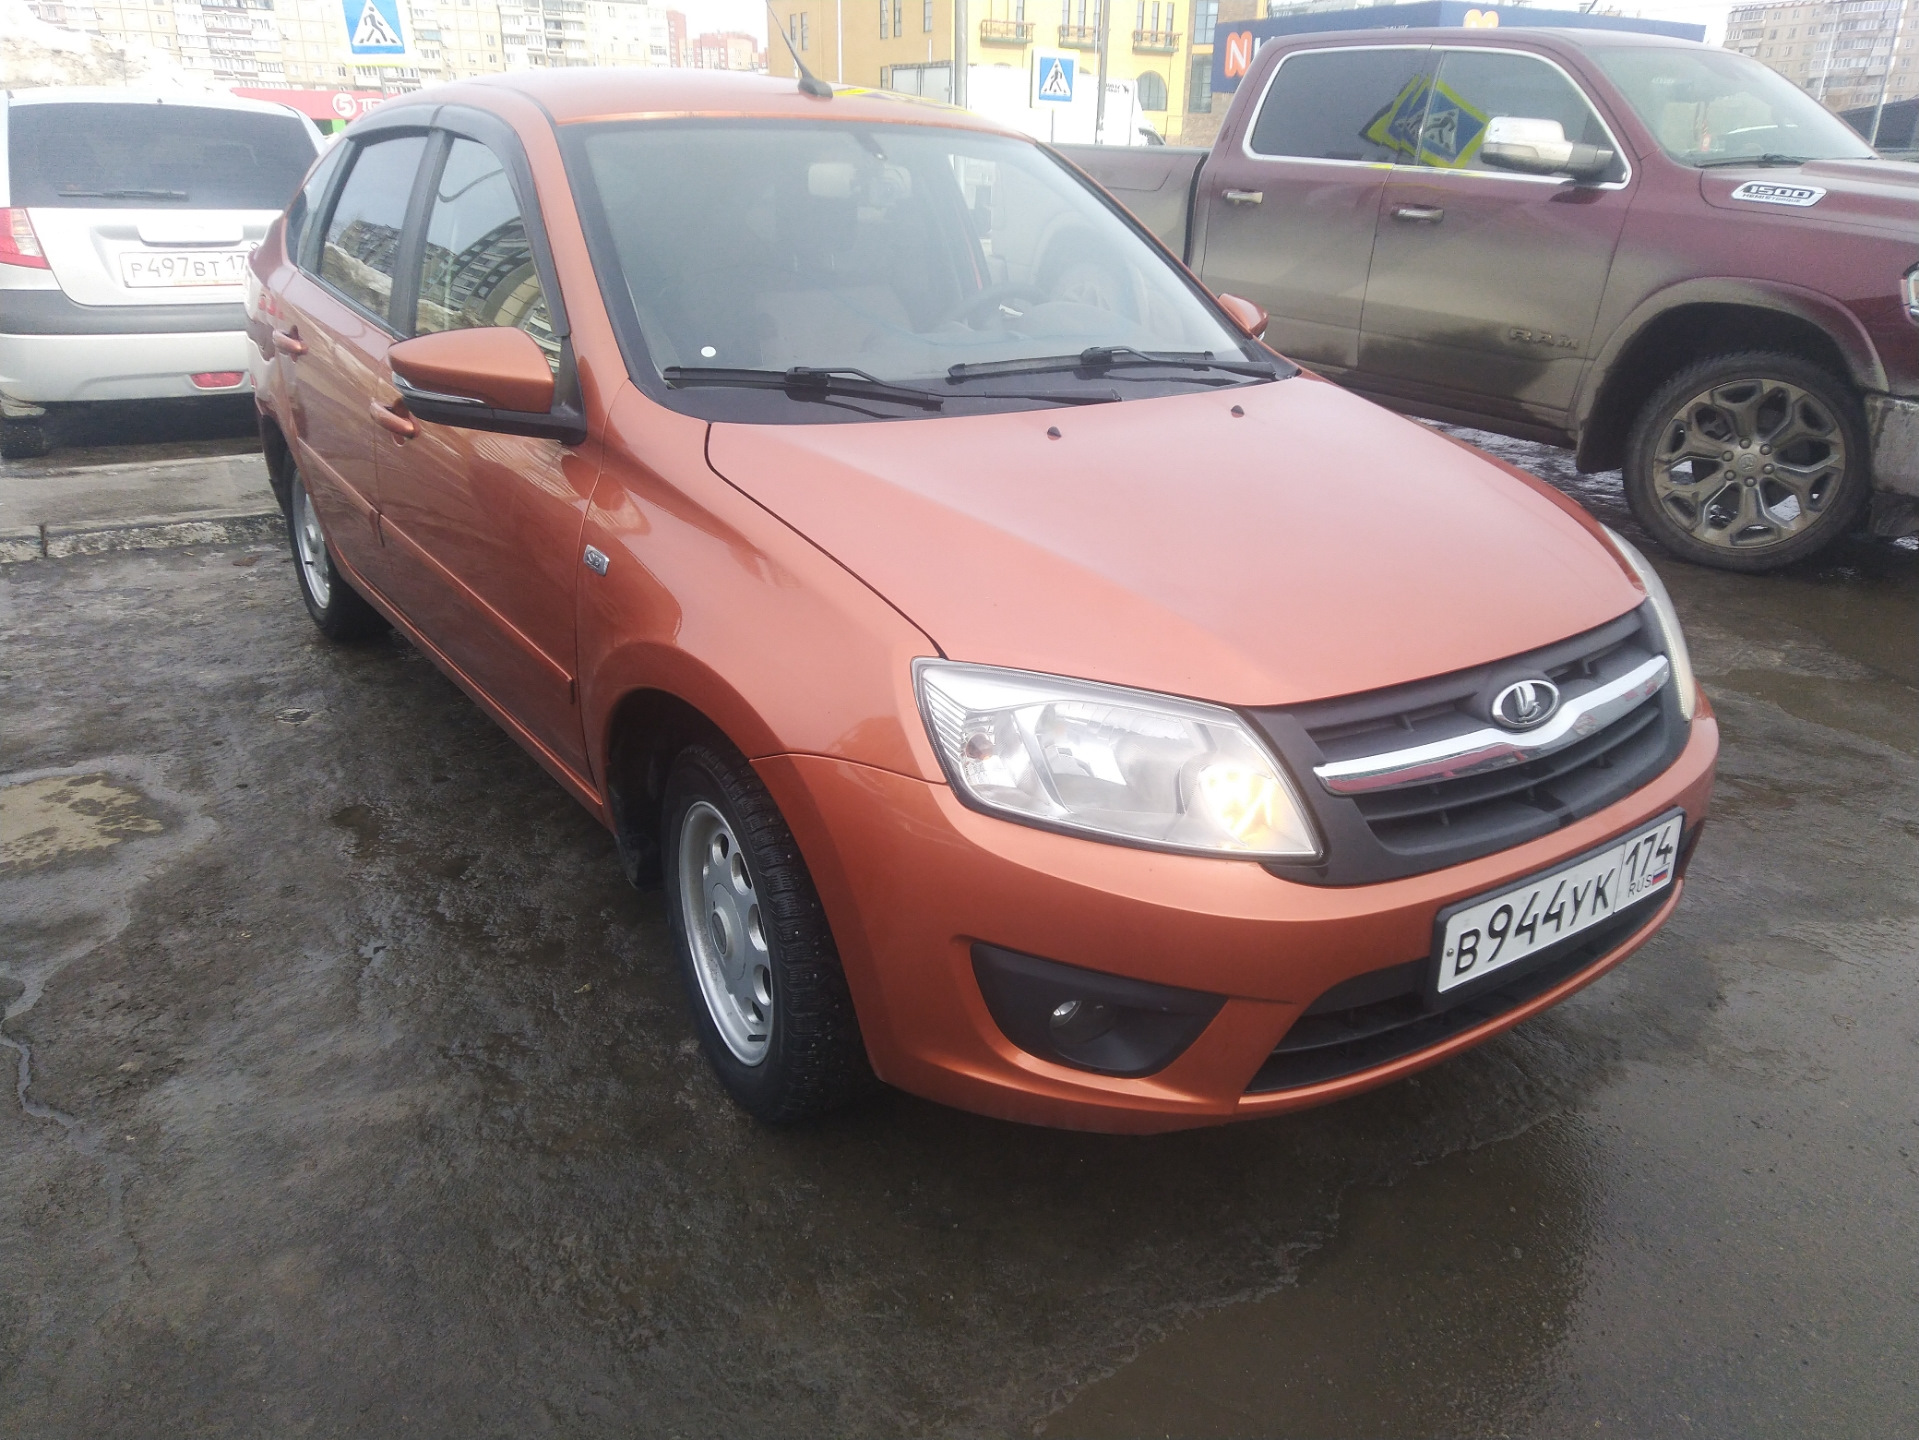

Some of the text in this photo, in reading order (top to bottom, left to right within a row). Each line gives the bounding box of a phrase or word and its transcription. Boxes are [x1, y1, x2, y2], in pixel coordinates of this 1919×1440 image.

[1749, 185, 1812, 199] 1500
[226, 254, 246, 271] 17
[1508, 327, 1579, 349] RAM
[1627, 873, 1653, 898] RUS
[1454, 825, 1674, 977] В944УК 174
